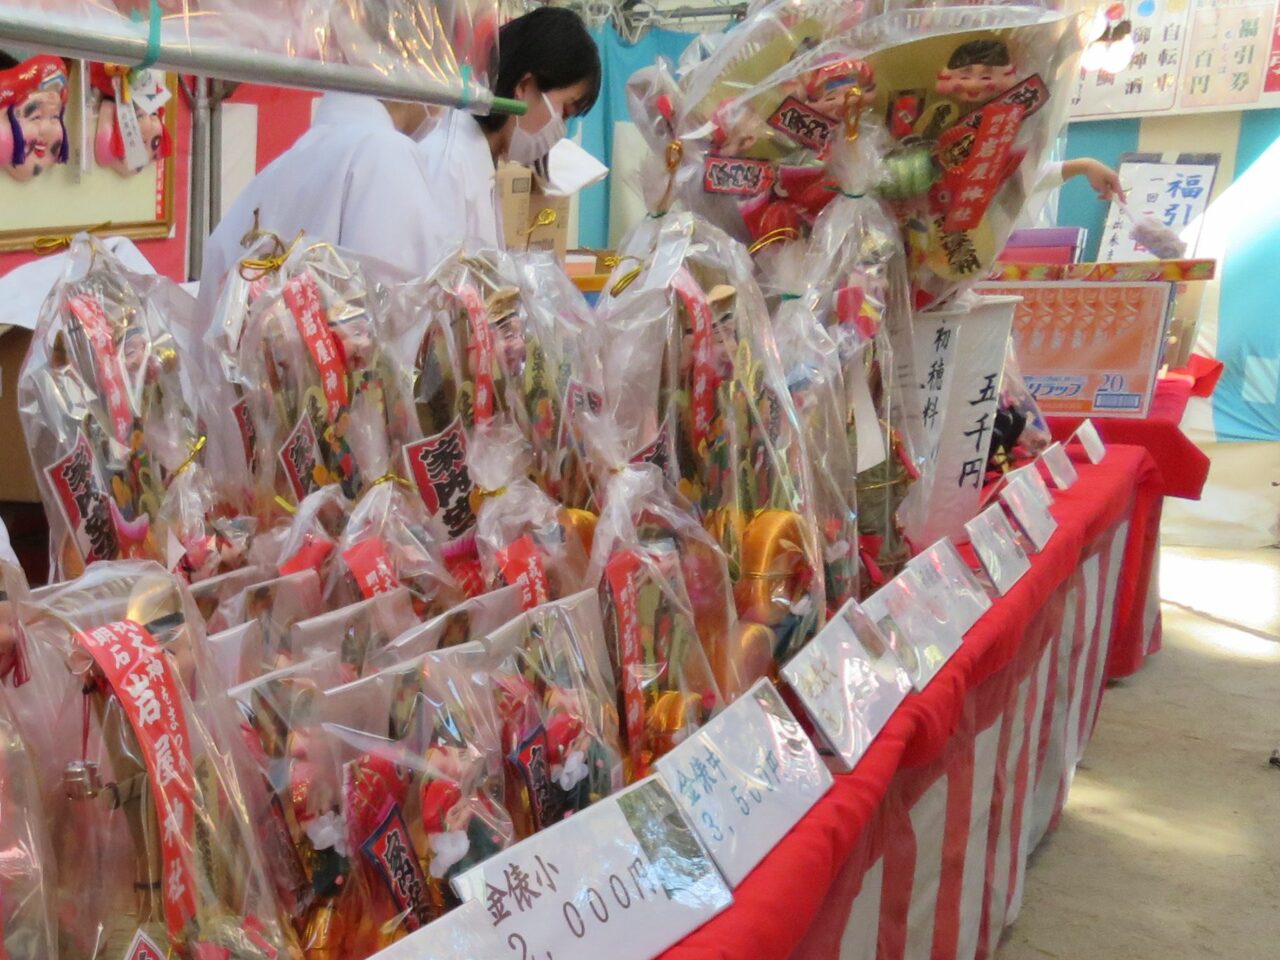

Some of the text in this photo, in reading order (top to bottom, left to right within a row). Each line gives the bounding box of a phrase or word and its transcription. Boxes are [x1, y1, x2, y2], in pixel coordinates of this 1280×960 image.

[1163, 172, 1204, 227] 福引
[923, 319, 952, 430] 初穂料
[958, 373, 999, 489] 五千円
[486, 854, 560, 927] 金俵小
